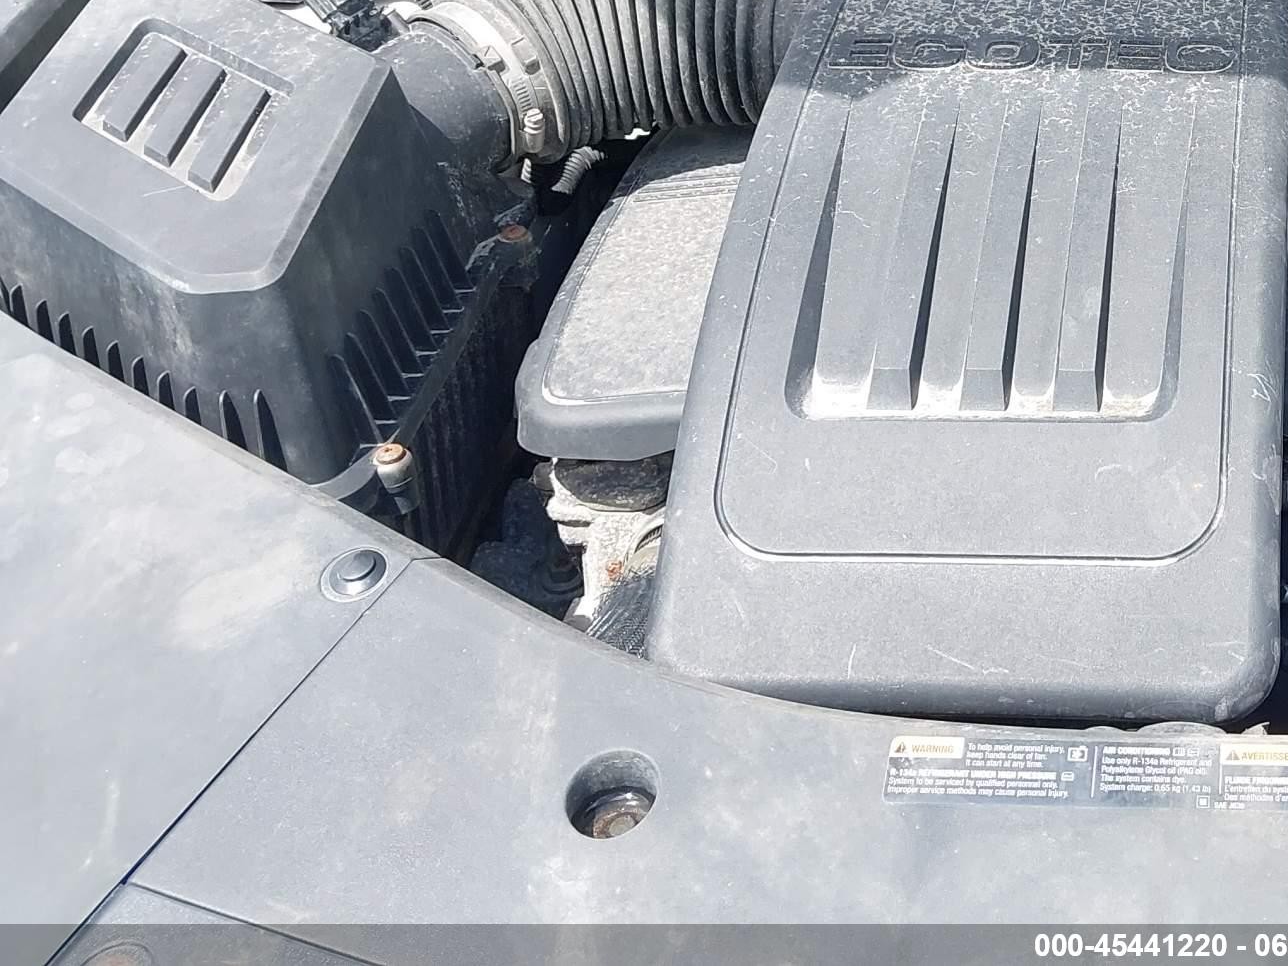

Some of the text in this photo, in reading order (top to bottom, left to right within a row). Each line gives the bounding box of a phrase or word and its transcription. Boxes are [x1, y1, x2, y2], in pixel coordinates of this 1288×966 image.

[826, 34, 1242, 74] ECOTEC
[911, 744, 955, 754] WARNING
[968, 743, 1065, 754] To help avoid personal injury.
[1026, 753, 1033, 761] of
[1102, 756, 1116, 764] Use
[1116, 757, 1131, 766] only
[1132, 757, 1159, 765] R-134a
[889, 777, 914, 786] System
[935, 778, 964, 786] serviced
[966, 779, 975, 787] by
[976, 779, 1006, 788] qualified
[1041, 781, 1058, 789] only.
[1101, 774, 1114, 782] The
[1115, 775, 1140, 783] system
[887, 785, 918, 795] Improper
[919, 786, 946, 794] service
[947, 787, 977, 795] methods
[978, 788, 993, 796] may
[1017, 789, 1047, 798] personal
[1100, 783, 1126, 793] System
[1127, 784, 1154, 793] charge:
[1154, 785, 1170, 793] 0.65
[1171, 785, 1182, 794] kg
[1262, 786, 1271, 794] du
[1224, 793, 1238, 801] Des
